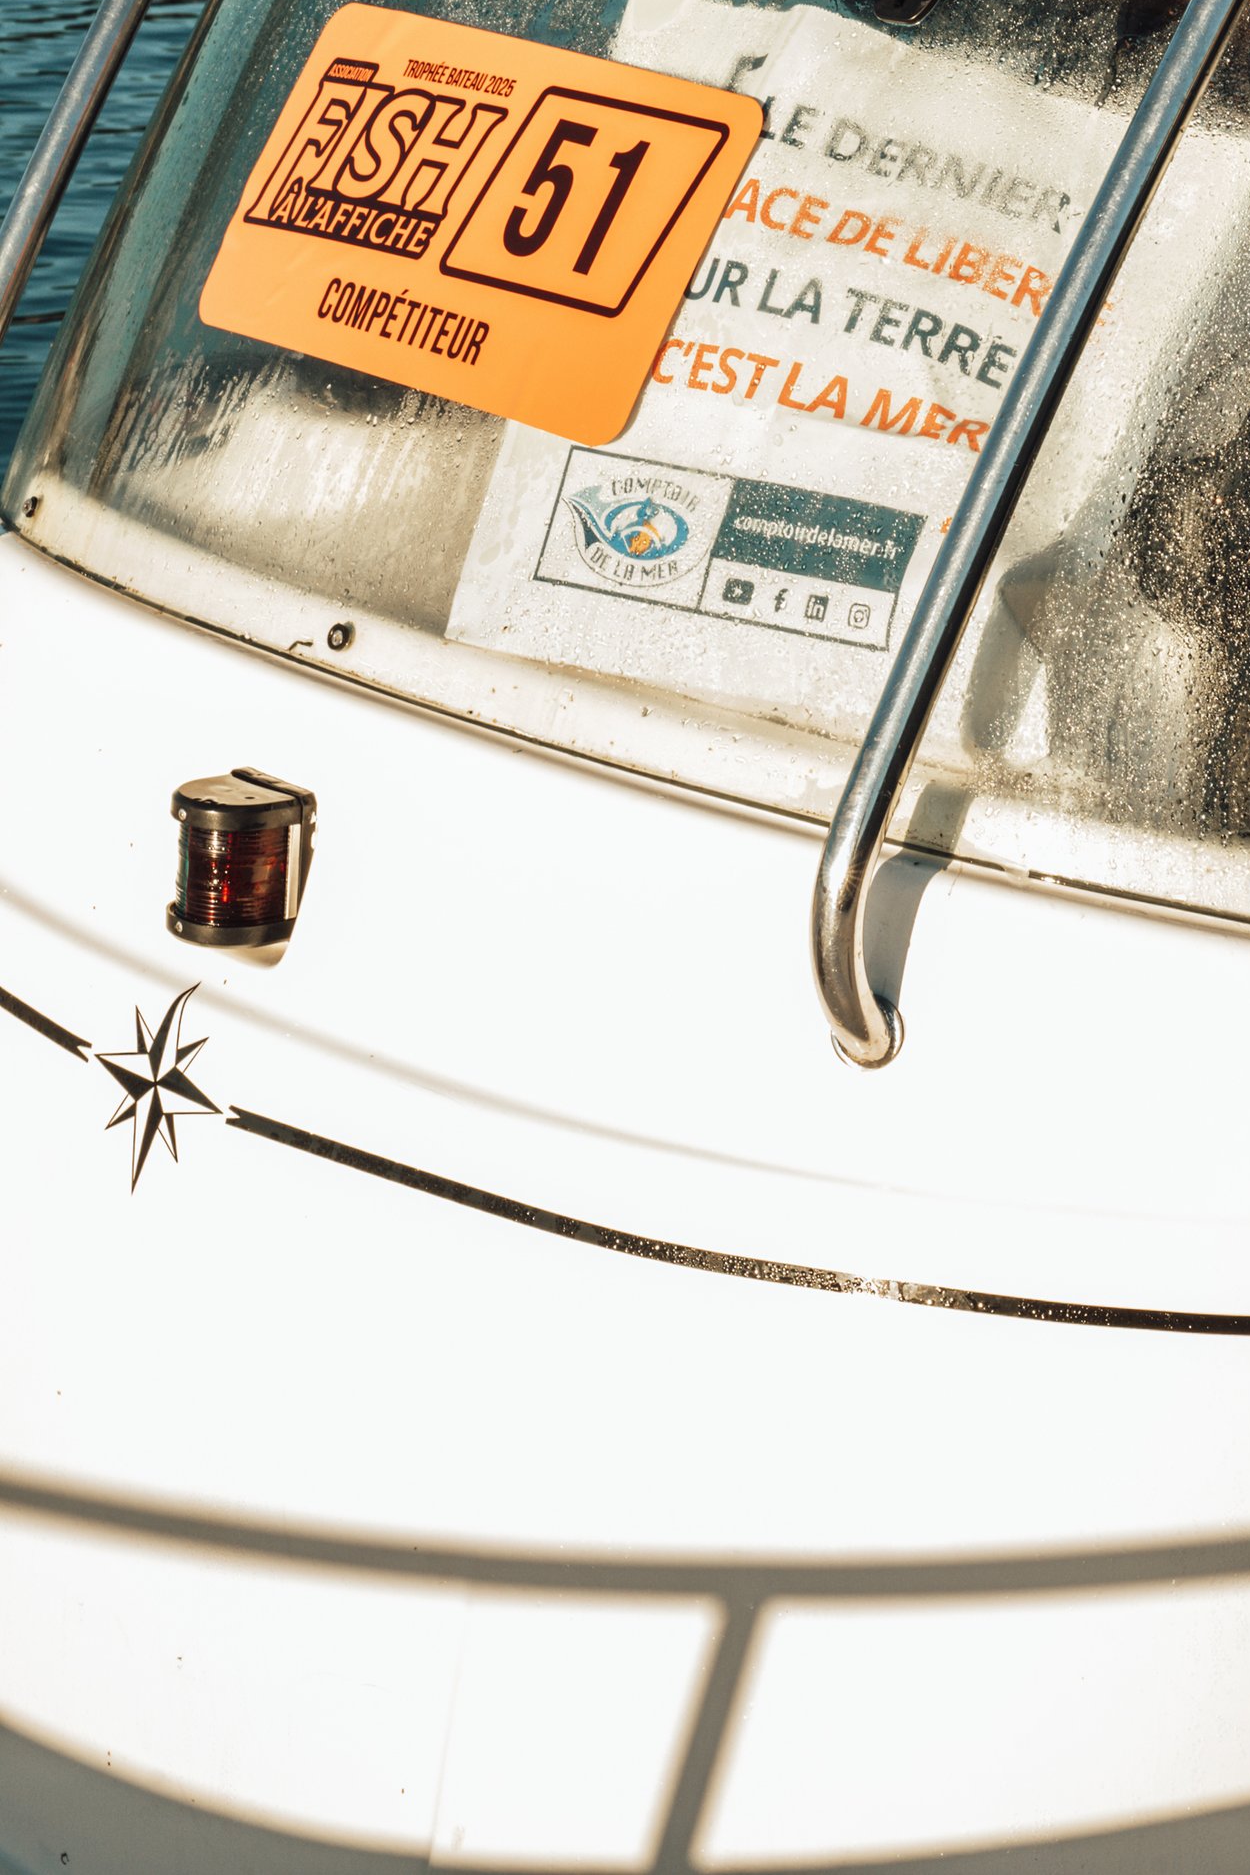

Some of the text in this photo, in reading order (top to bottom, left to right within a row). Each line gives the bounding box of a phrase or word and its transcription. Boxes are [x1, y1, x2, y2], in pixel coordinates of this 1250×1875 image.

[328, 63, 375, 82] ASSOCIATION
[403, 58, 517, 98] TROPHÉE BATEAU 2025
[244, 80, 509, 221] FISH
[272, 177, 437, 254] À L'AFFICHE
[502, 119, 651, 275] 51
[724, 178, 1052, 317] ACE DE LIBER
[317, 277, 490, 366] COMPÉTITEUR
[683, 257, 1018, 390] UR LA TERRE
[652, 339, 990, 453] C'EST LA MER
[611, 477, 700, 513] COMPTOIR
[590, 547, 679, 582] DE LA MER
[733, 516, 900, 561] comptoirdelamer.fr
